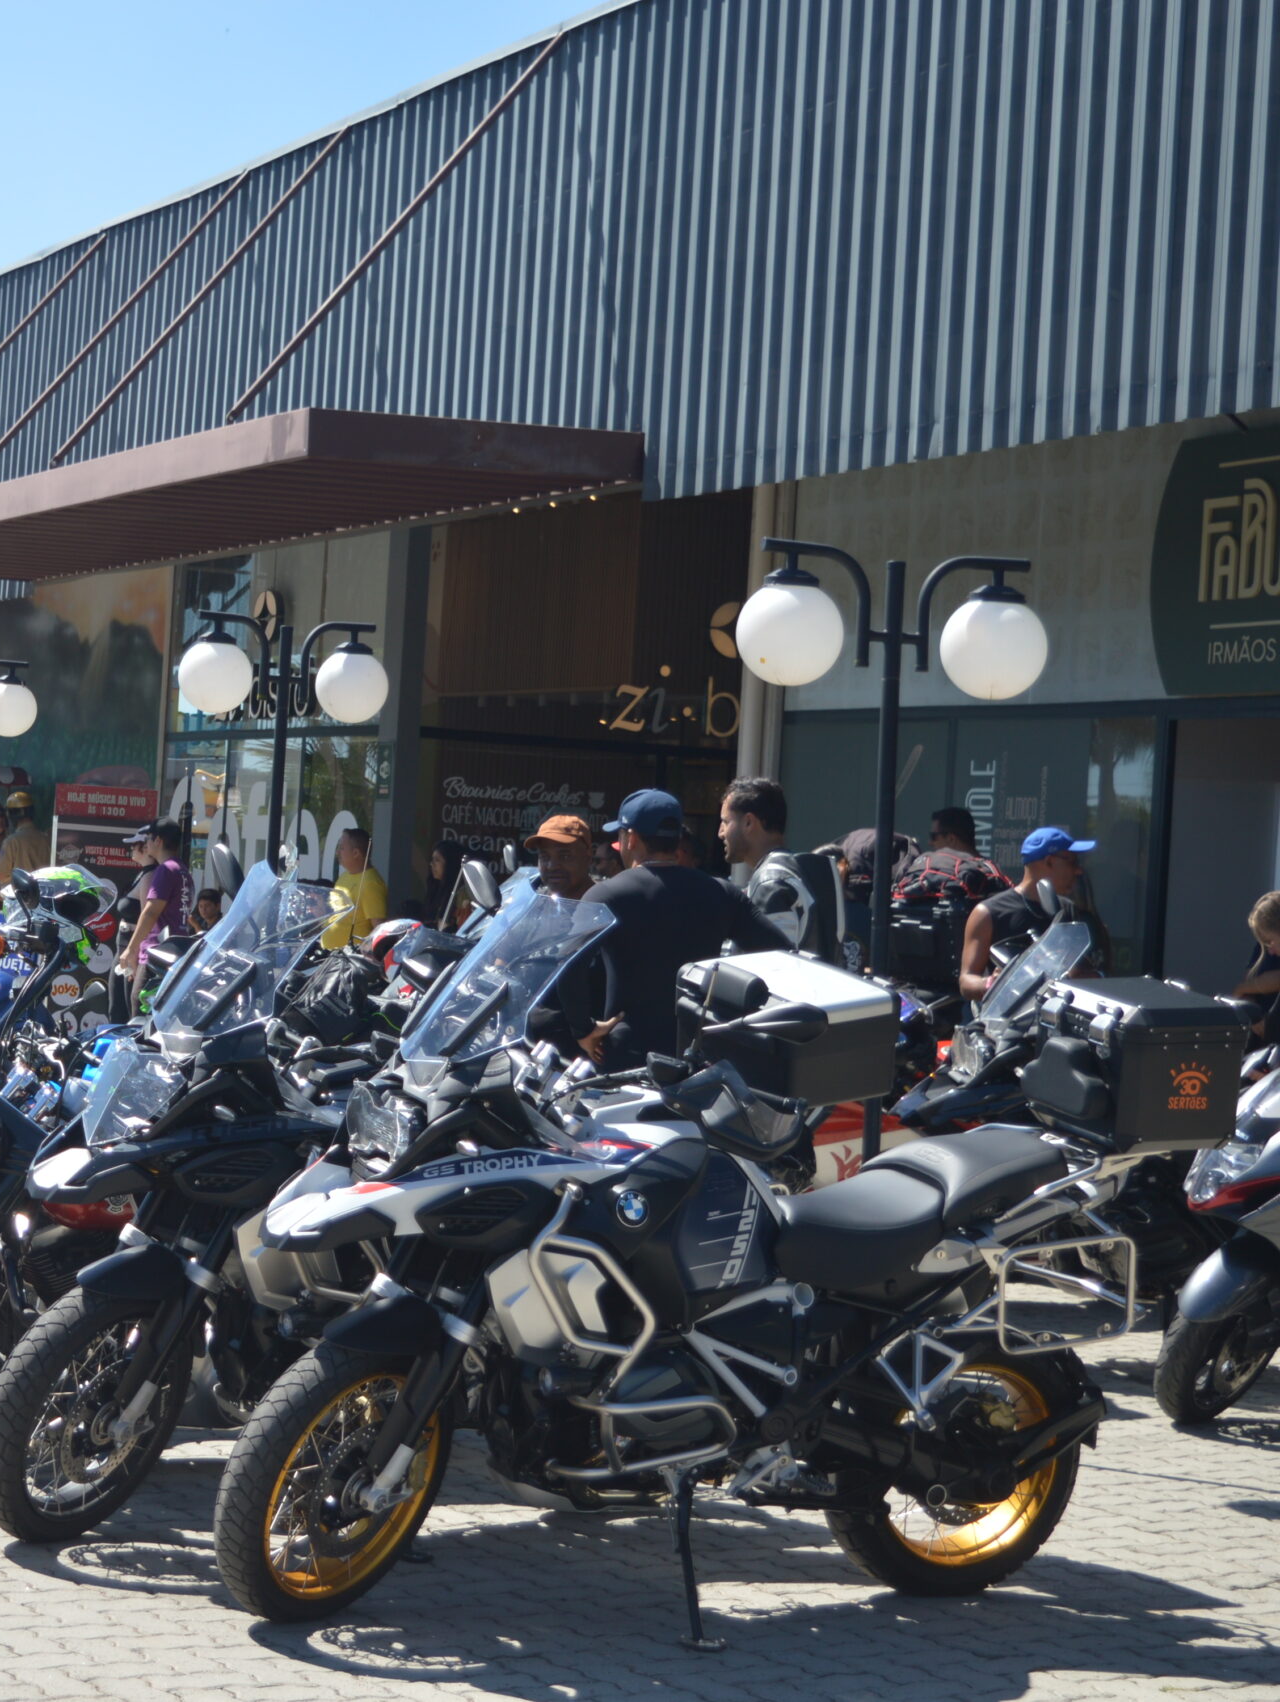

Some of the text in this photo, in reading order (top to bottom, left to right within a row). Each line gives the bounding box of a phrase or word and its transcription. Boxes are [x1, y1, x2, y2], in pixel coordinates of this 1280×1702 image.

[1207, 635, 1277, 664] IRMÃOS
[68, 792, 146, 807] HOJE MÚSICA AO VIVO
[443, 776, 518, 800] Brownies
[526, 782, 584, 806] Cookies
[442, 801, 472, 825] CAFÉ
[85, 846, 104, 855] VISITE
[110, 848, 126, 857] MALL
[97, 857, 106, 865] 20
[1180, 1079, 1200, 1095] 30
[423, 1154, 541, 1179] GS TROPHY
